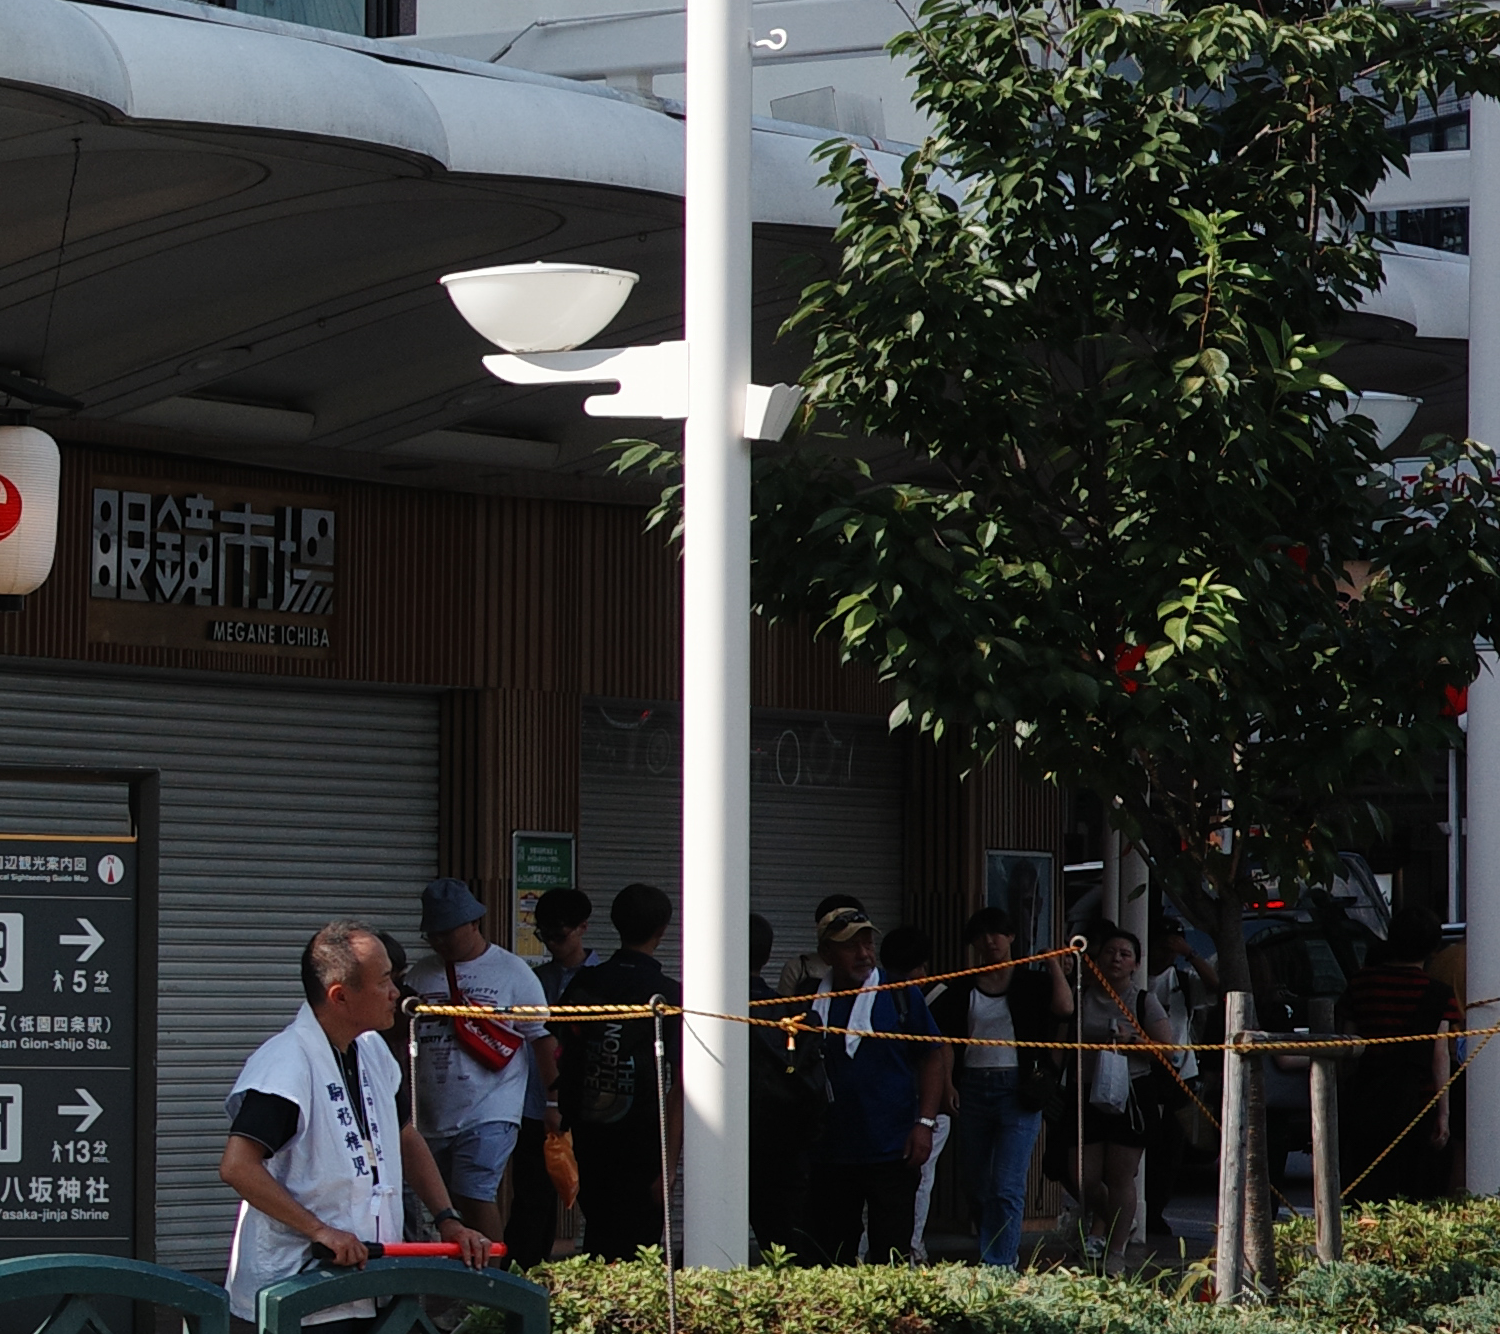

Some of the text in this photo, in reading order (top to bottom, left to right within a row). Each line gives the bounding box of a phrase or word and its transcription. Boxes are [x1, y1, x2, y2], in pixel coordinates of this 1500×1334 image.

[90, 487, 337, 616] 眼鏡市場
[212, 620, 331, 649] MEGANE ICHIBA
[10, 873, 51, 883] Sightseeing
[73, 874, 90, 884] Map
[71, 969, 88, 994] 5
[20, 1037, 85, 1052] Gion-shijo
[87, 1038, 112, 1050] Sta.
[600, 1022, 623, 1092] NORTH
[618, 1055, 636, 1095] THE
[64, 1139, 91, 1163] 13
[0, 1176, 111, 1204] 八坂神社
[70, 1208, 110, 1221] Shrine
